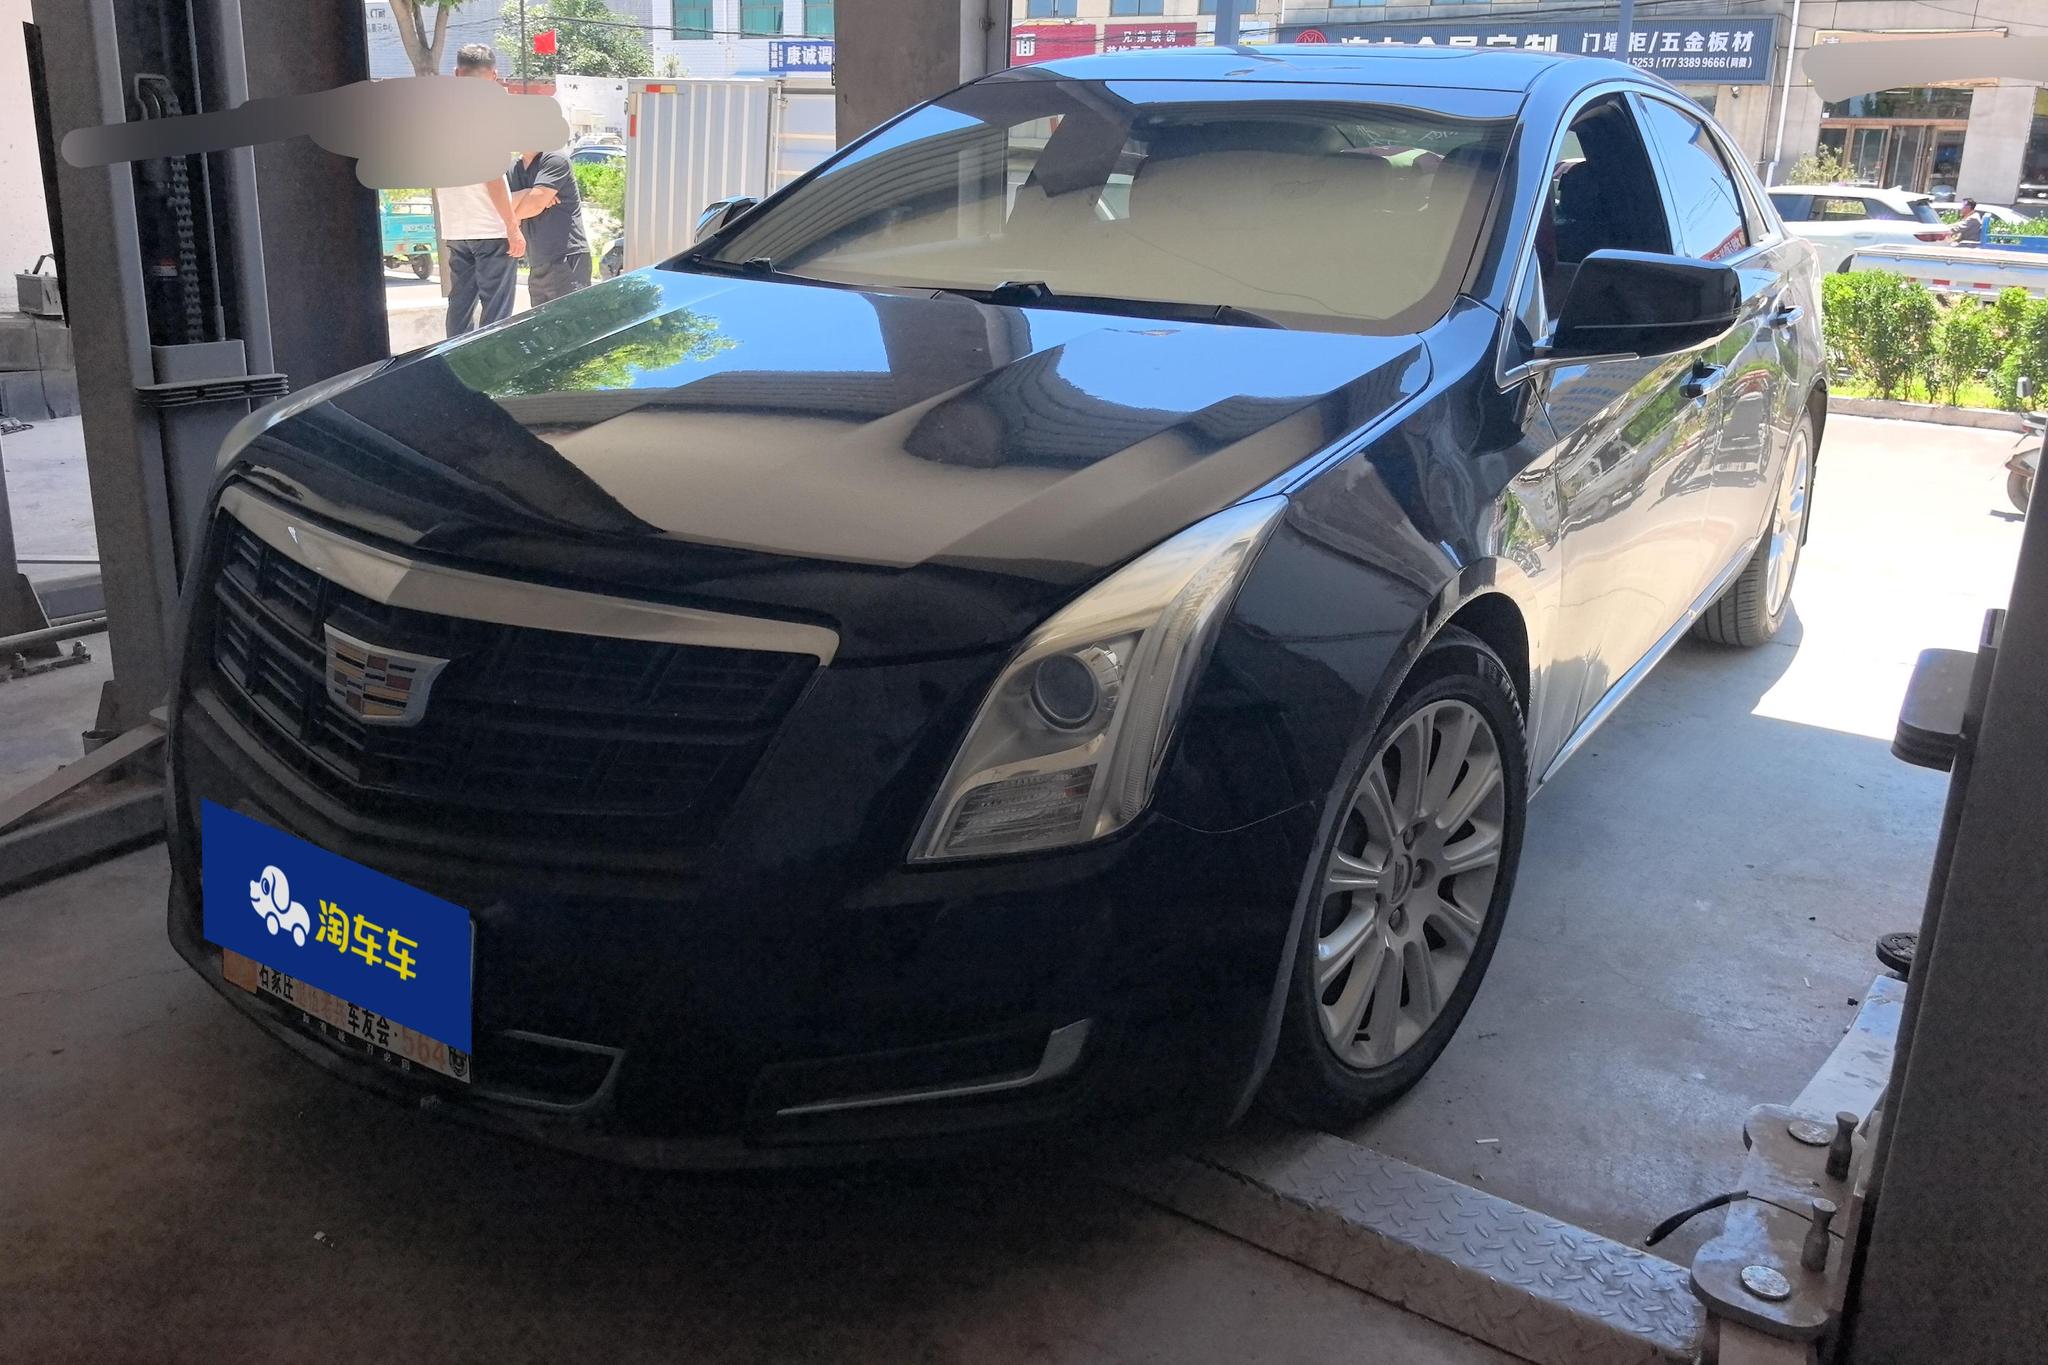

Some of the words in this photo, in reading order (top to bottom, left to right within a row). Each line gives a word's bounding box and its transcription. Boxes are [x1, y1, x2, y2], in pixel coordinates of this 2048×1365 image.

[1581, 31, 1754, 53] 门墙柜/五金板材
[787, 45, 835, 65] 康诚调
